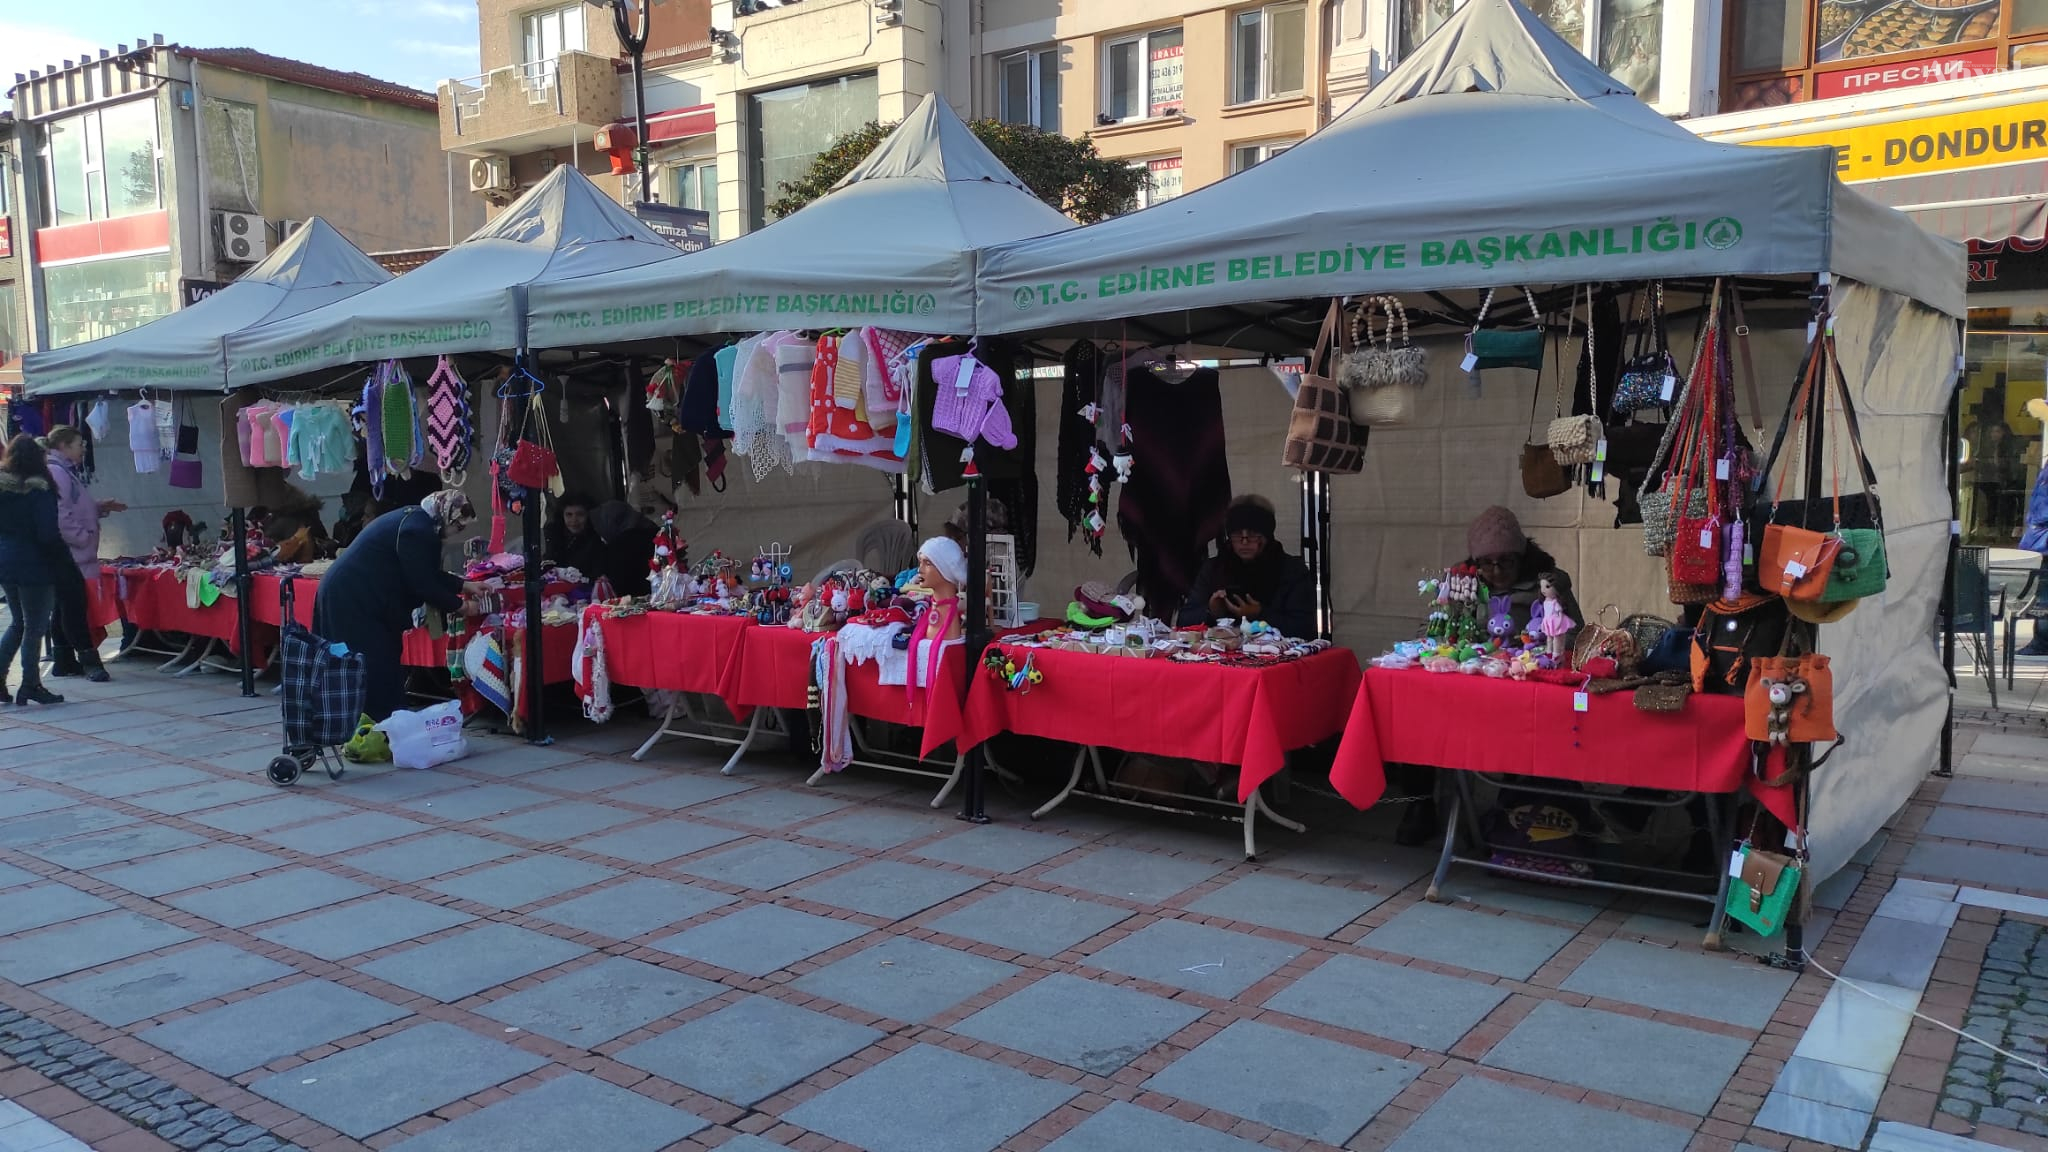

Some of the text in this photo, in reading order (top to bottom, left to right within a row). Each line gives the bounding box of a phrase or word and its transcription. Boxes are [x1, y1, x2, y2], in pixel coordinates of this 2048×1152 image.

[1843, 60, 1964, 89] ПРЕСНИ
[1884, 119, 2048, 167] DONDUR
[1037, 280, 1087, 305] T.C.
[1098, 262, 1216, 298] EDİRNE
[1227, 242, 1406, 282] BELEDİYE
[1420, 216, 1697, 270] BAŞKANLIĞI
[566, 289, 914, 329] T.C. EDİRNE BELEDİYE BAŞKANLIĞI
[390, 320, 479, 347] BAŞKANLIĞI
